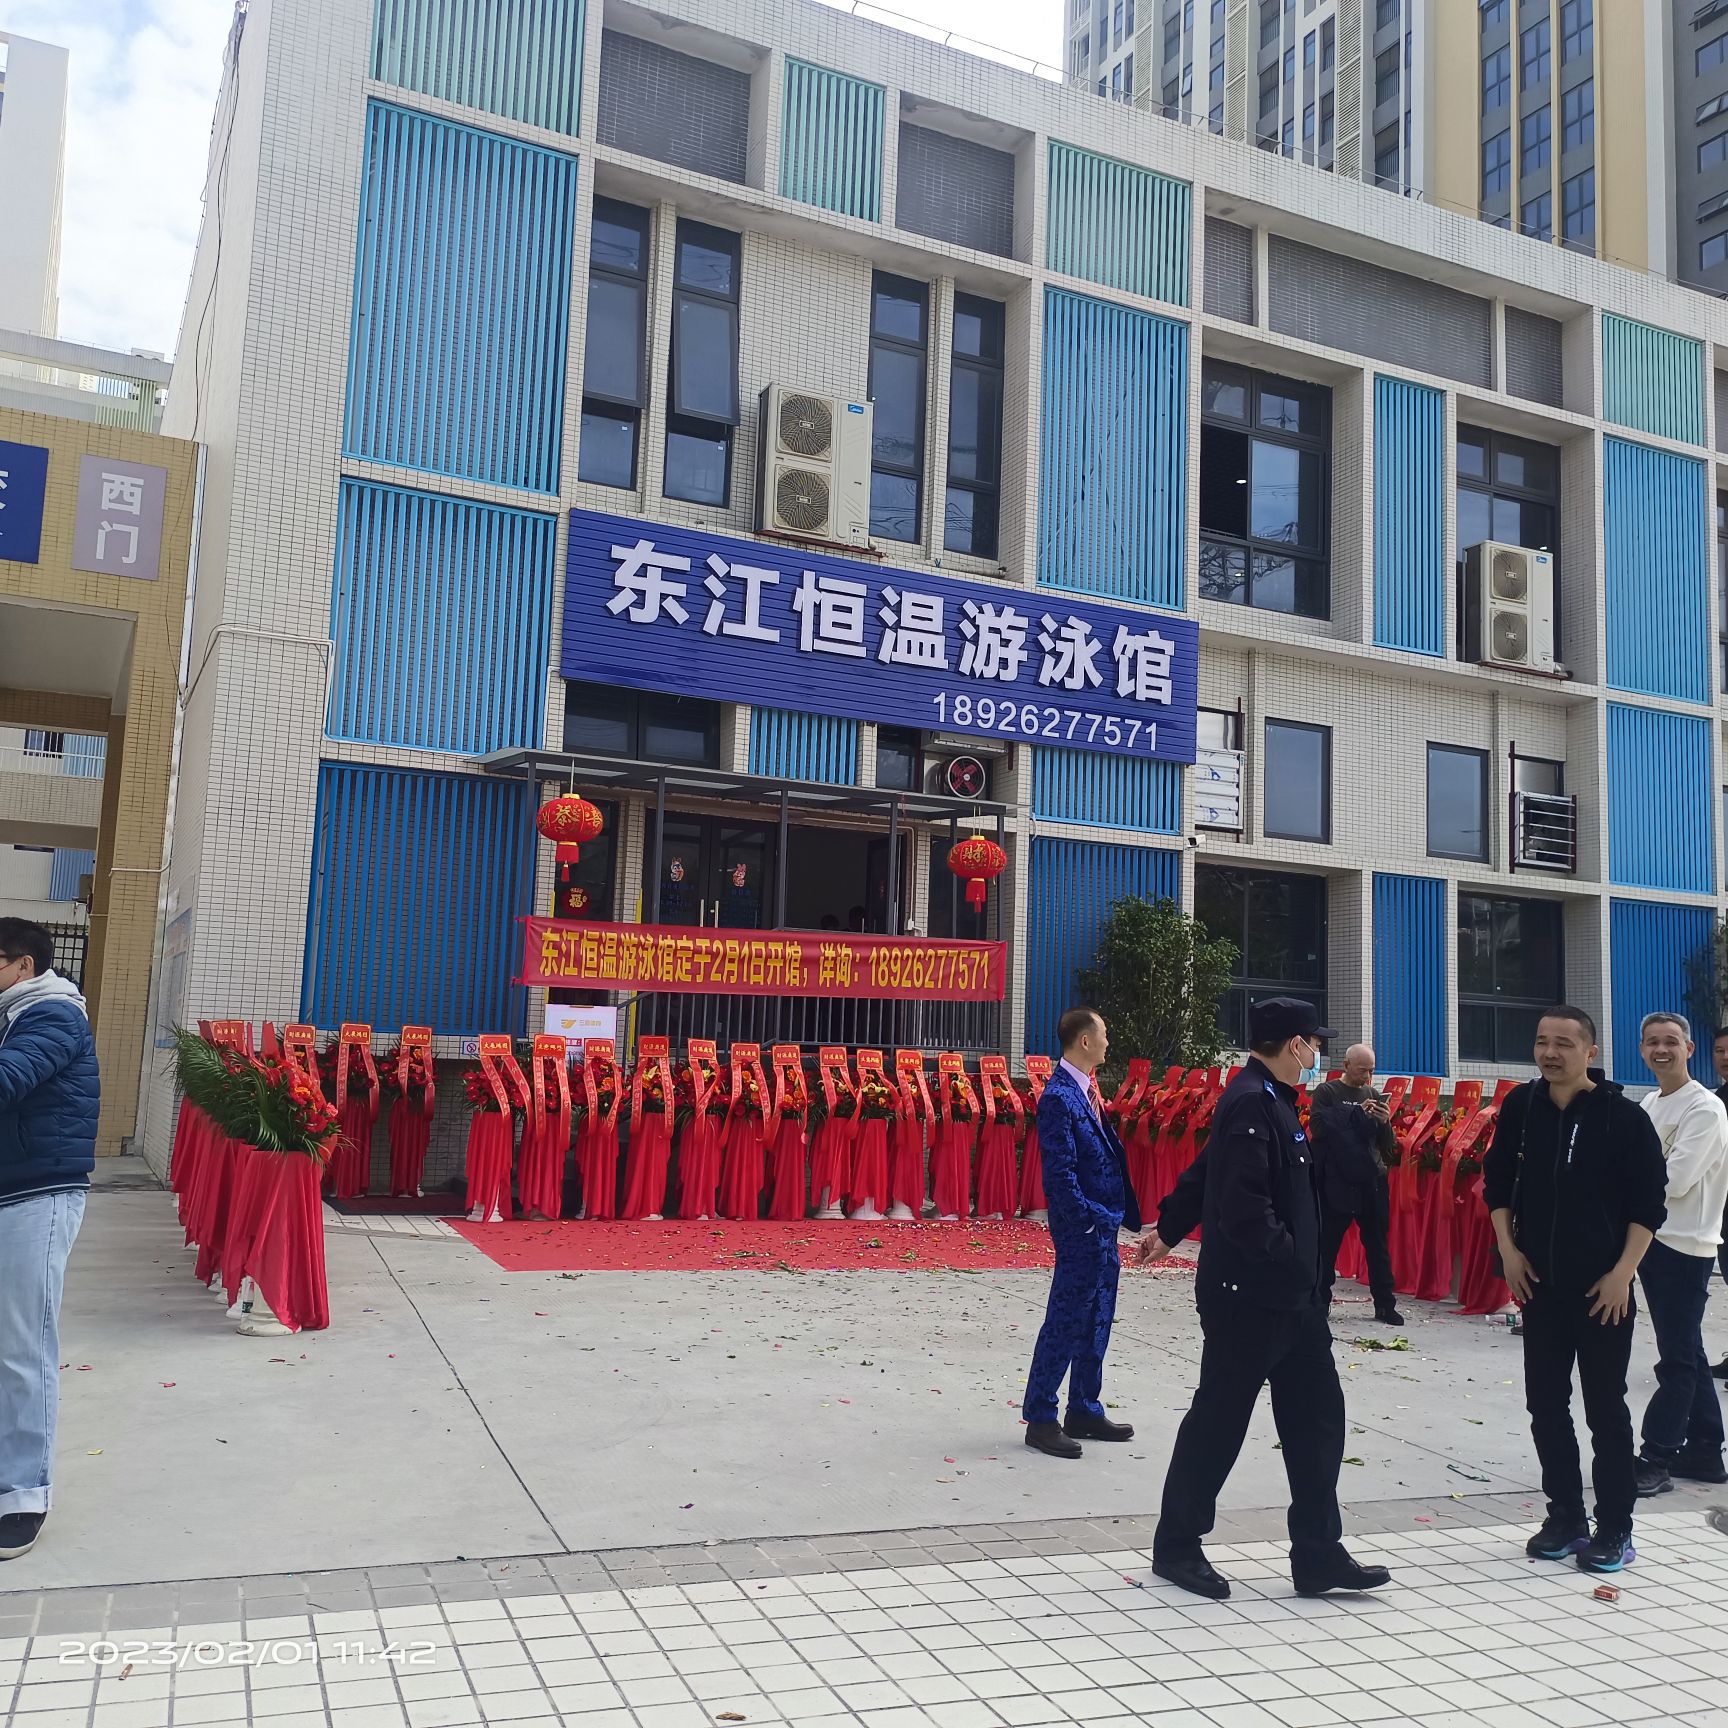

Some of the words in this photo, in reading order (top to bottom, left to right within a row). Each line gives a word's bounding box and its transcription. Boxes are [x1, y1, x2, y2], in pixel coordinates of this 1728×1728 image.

[95, 472, 144, 564] 西门
[606, 539, 1175, 705] 东江恒温游泳馆
[933, 692, 1158, 752] 18926277571
